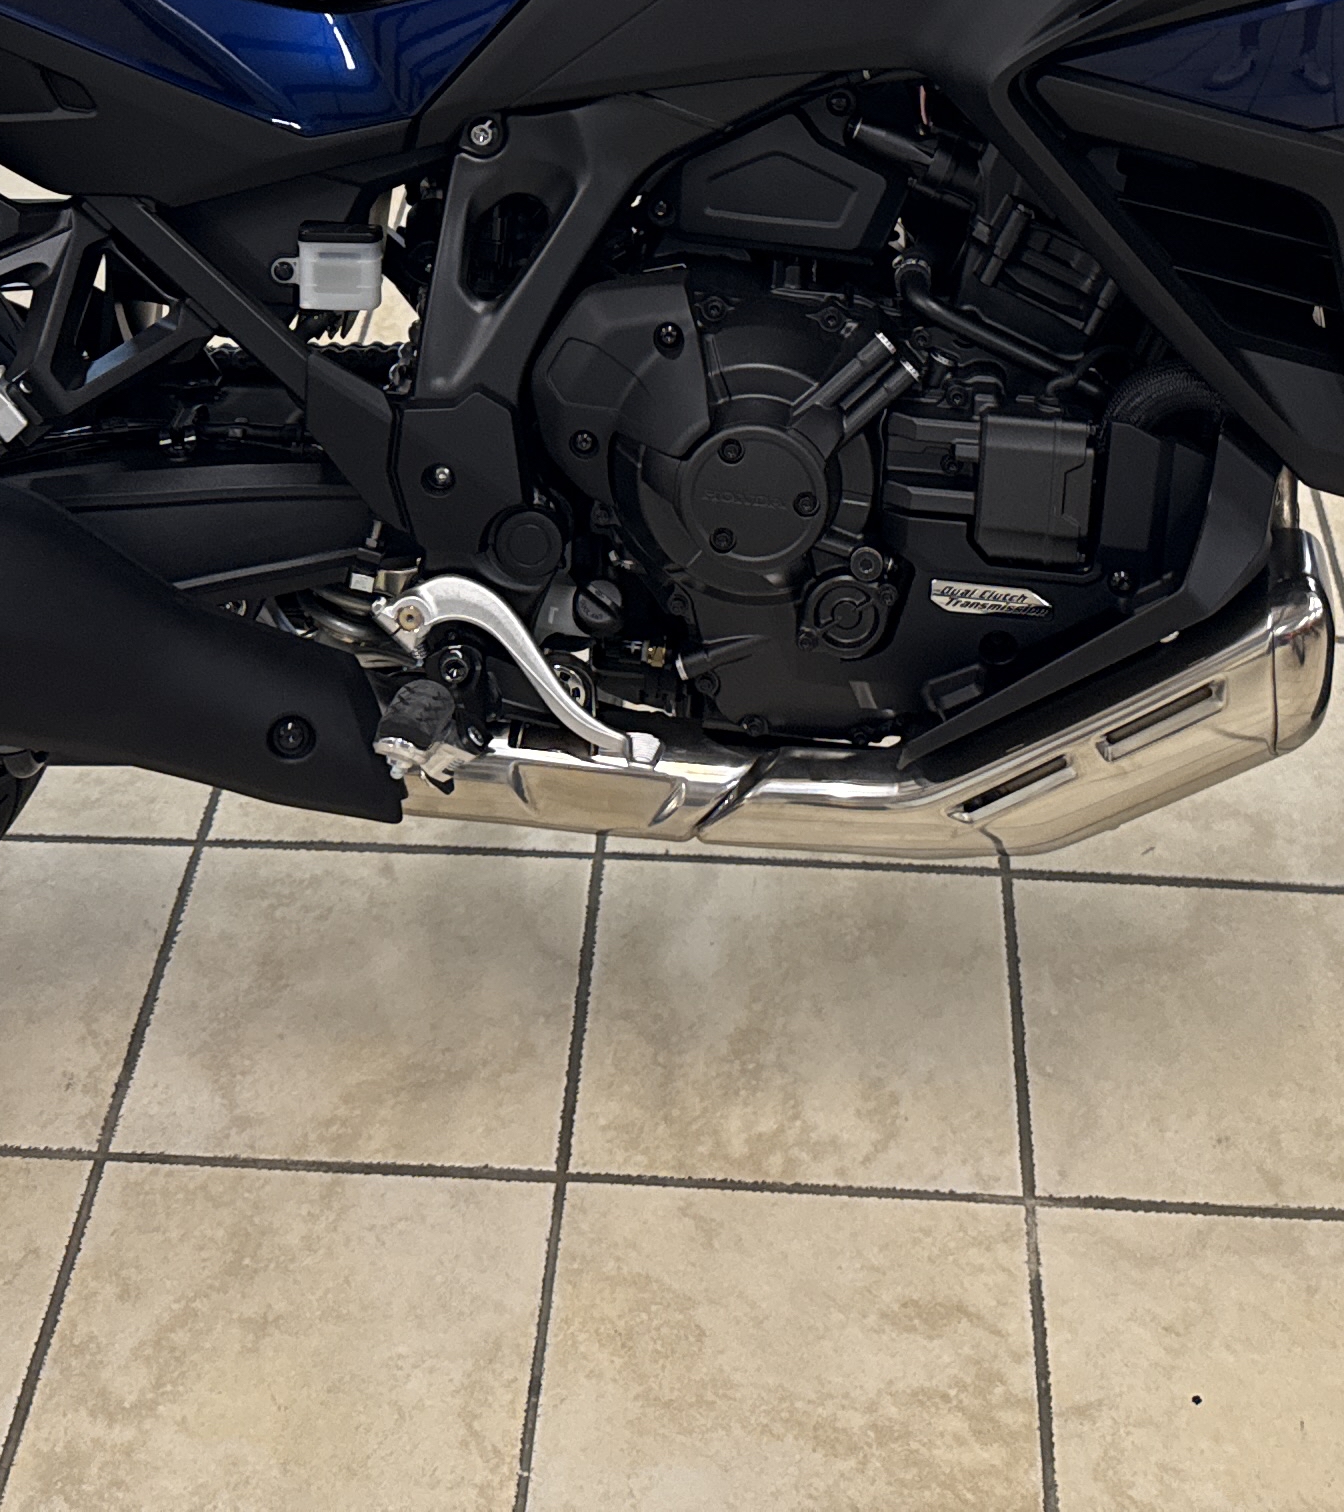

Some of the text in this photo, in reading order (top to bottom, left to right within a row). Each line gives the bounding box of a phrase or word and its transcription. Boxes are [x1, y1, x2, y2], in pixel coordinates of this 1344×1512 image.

[939, 585, 1029, 604] Dual Clutch
[944, 596, 1050, 617] Transmission
